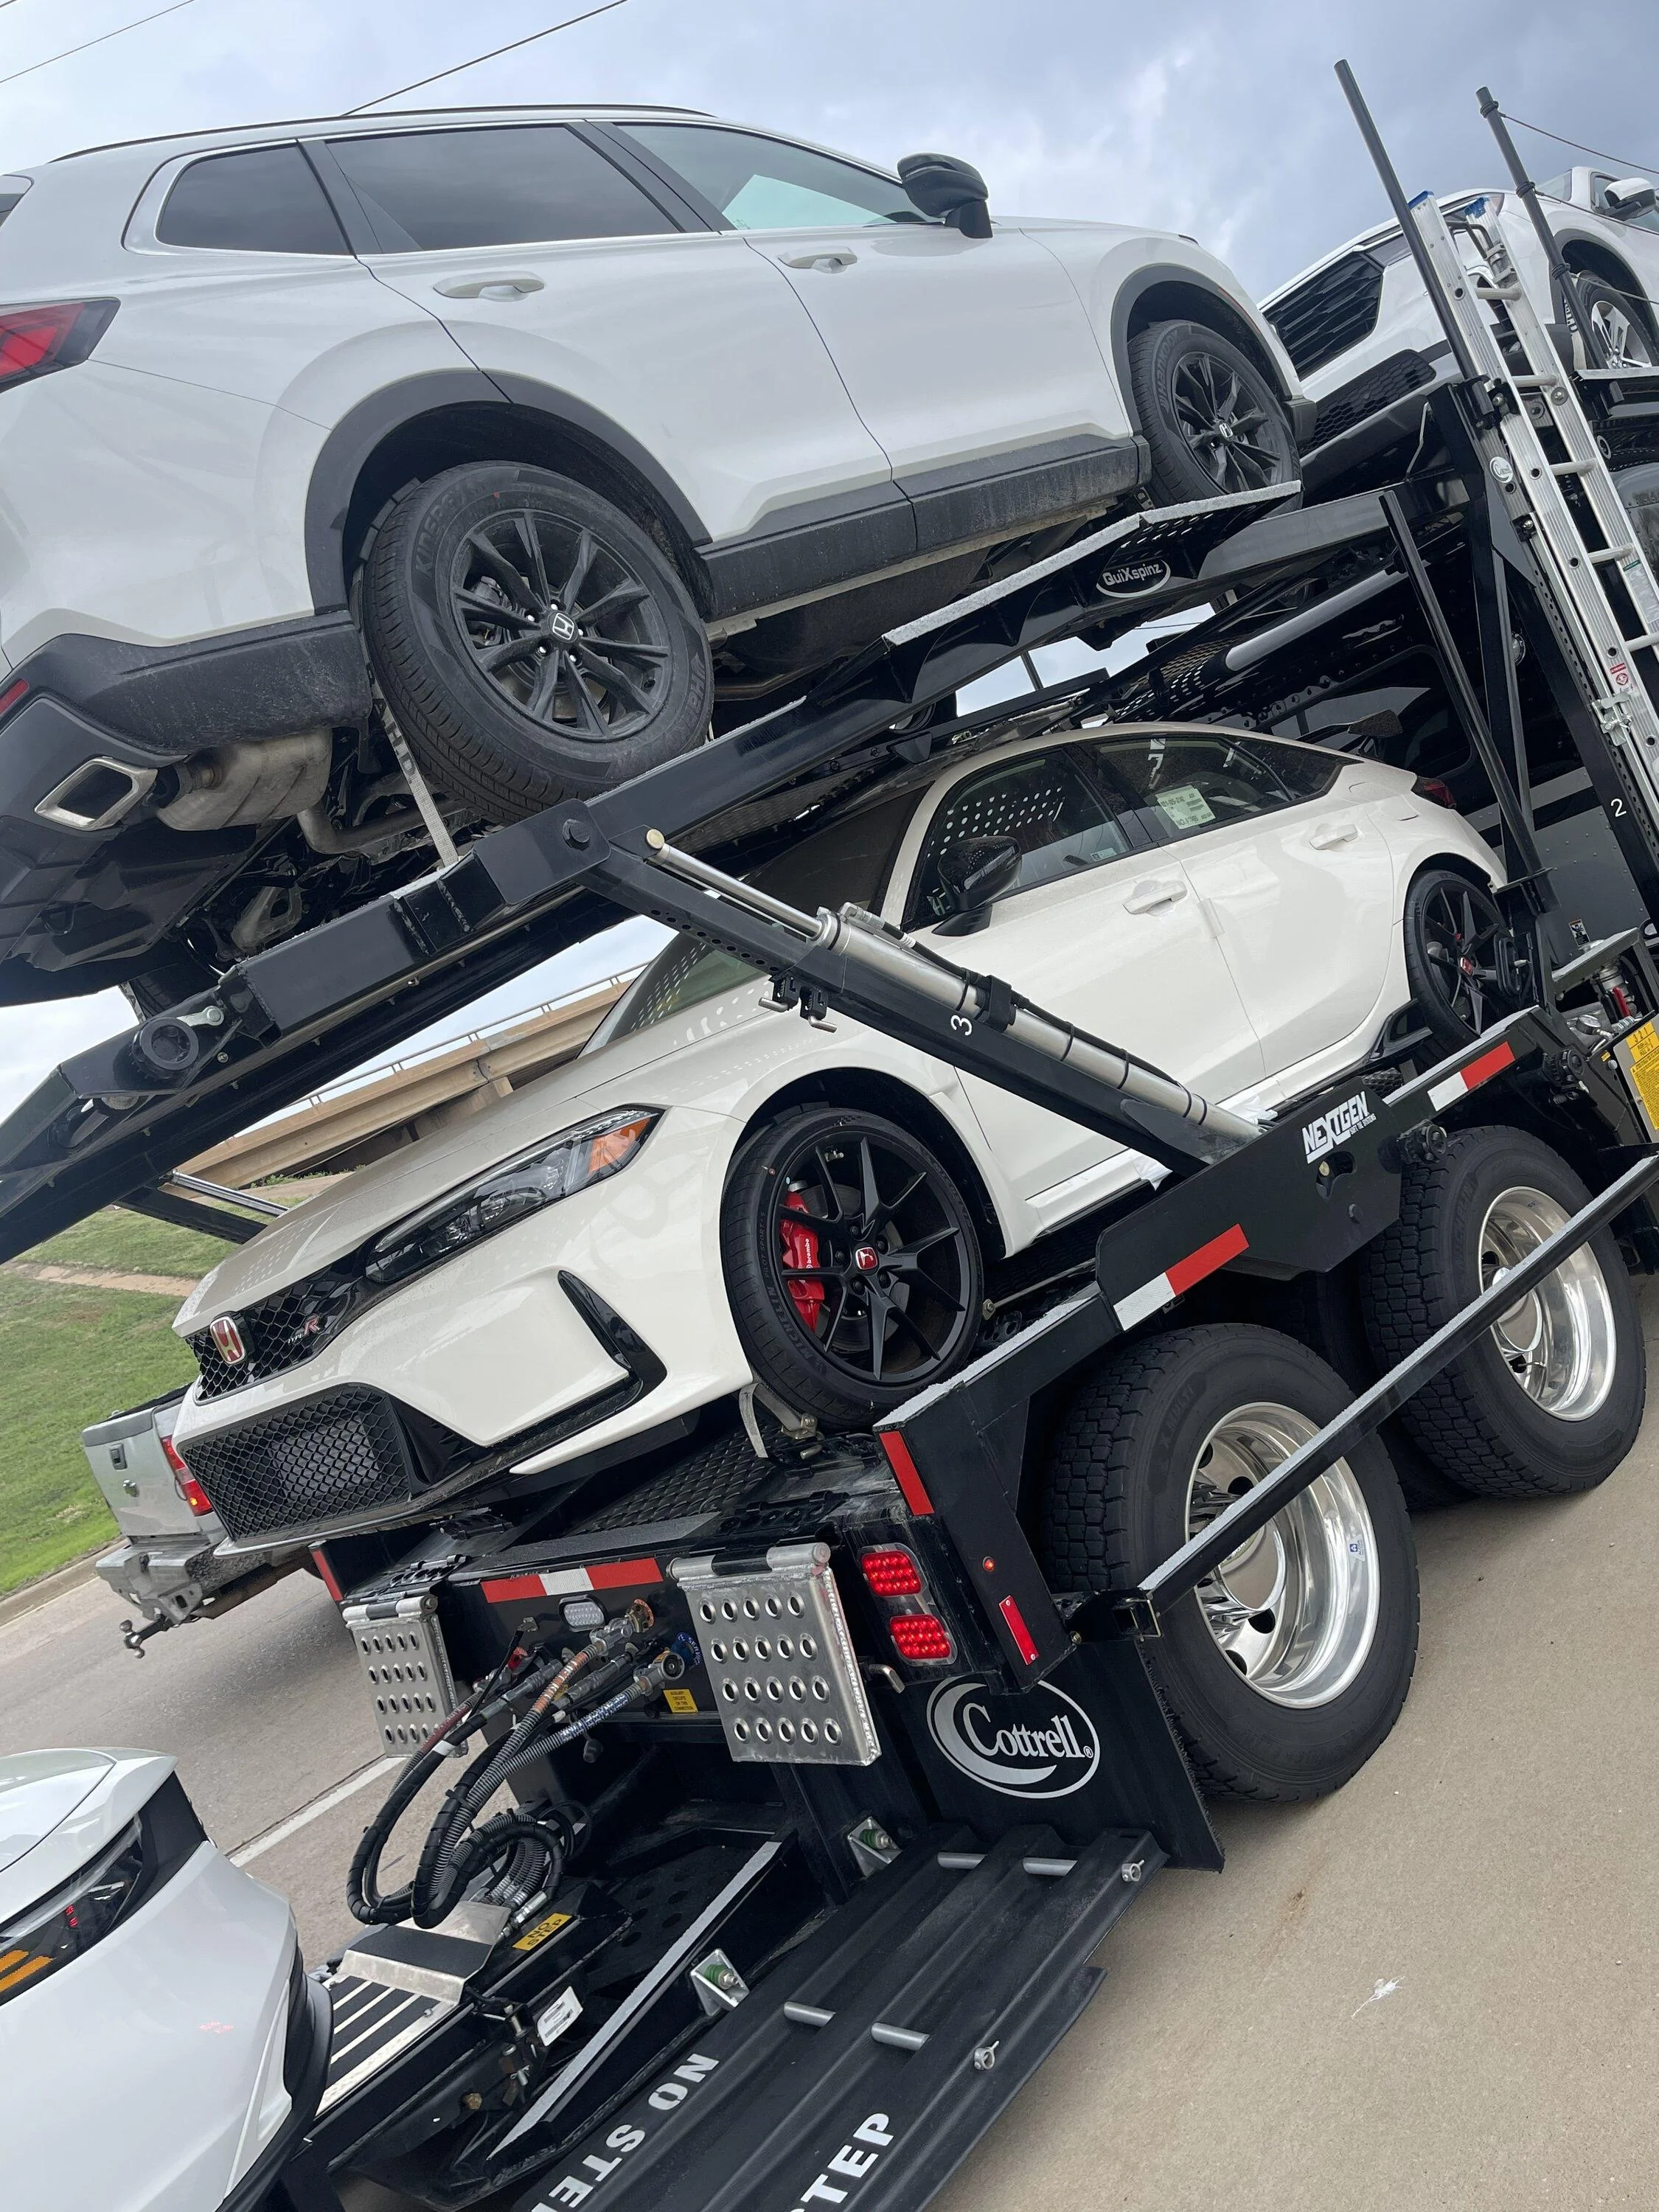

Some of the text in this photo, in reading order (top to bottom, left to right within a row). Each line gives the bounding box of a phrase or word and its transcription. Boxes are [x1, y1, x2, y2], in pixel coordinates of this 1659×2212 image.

[1611, 799, 1627, 817] 2
[950, 1015, 973, 1036] 3
[1302, 1091, 1370, 1164] NEXTGEN
[963, 1703, 1085, 1758] Cottrell
[526, 1919, 563, 1947] STEP
[527, 1922, 550, 1939] NO
[647, 2053, 720, 2110] NO
[789, 2112, 895, 2212] TEP
